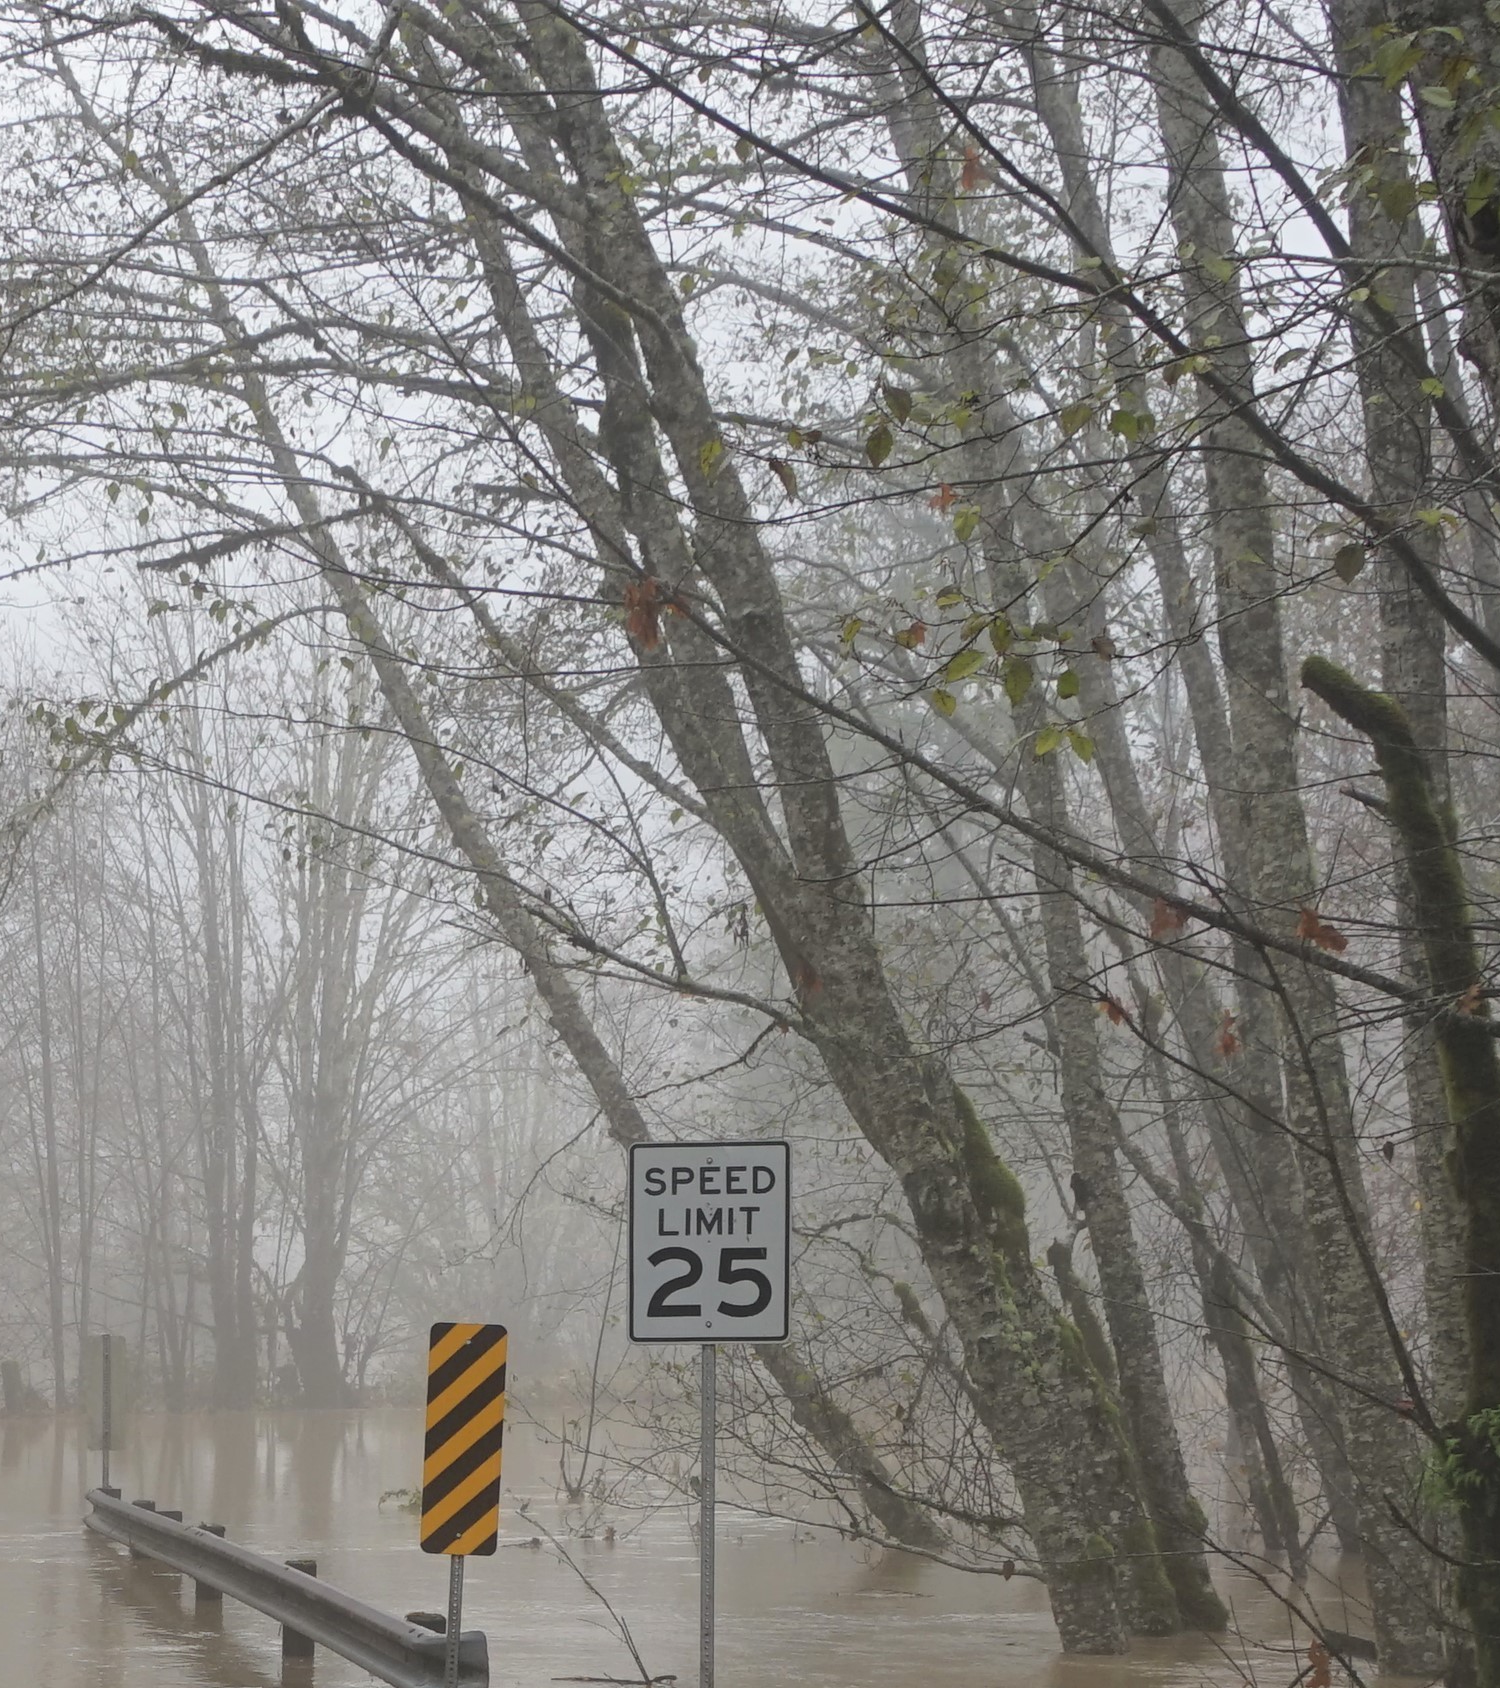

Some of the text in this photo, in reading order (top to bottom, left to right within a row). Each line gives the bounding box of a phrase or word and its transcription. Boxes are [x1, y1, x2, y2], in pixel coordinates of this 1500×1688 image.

[644, 1166, 776, 1196] SPEED
[659, 1207, 760, 1236] LIMIT
[647, 1247, 772, 1317] 25
